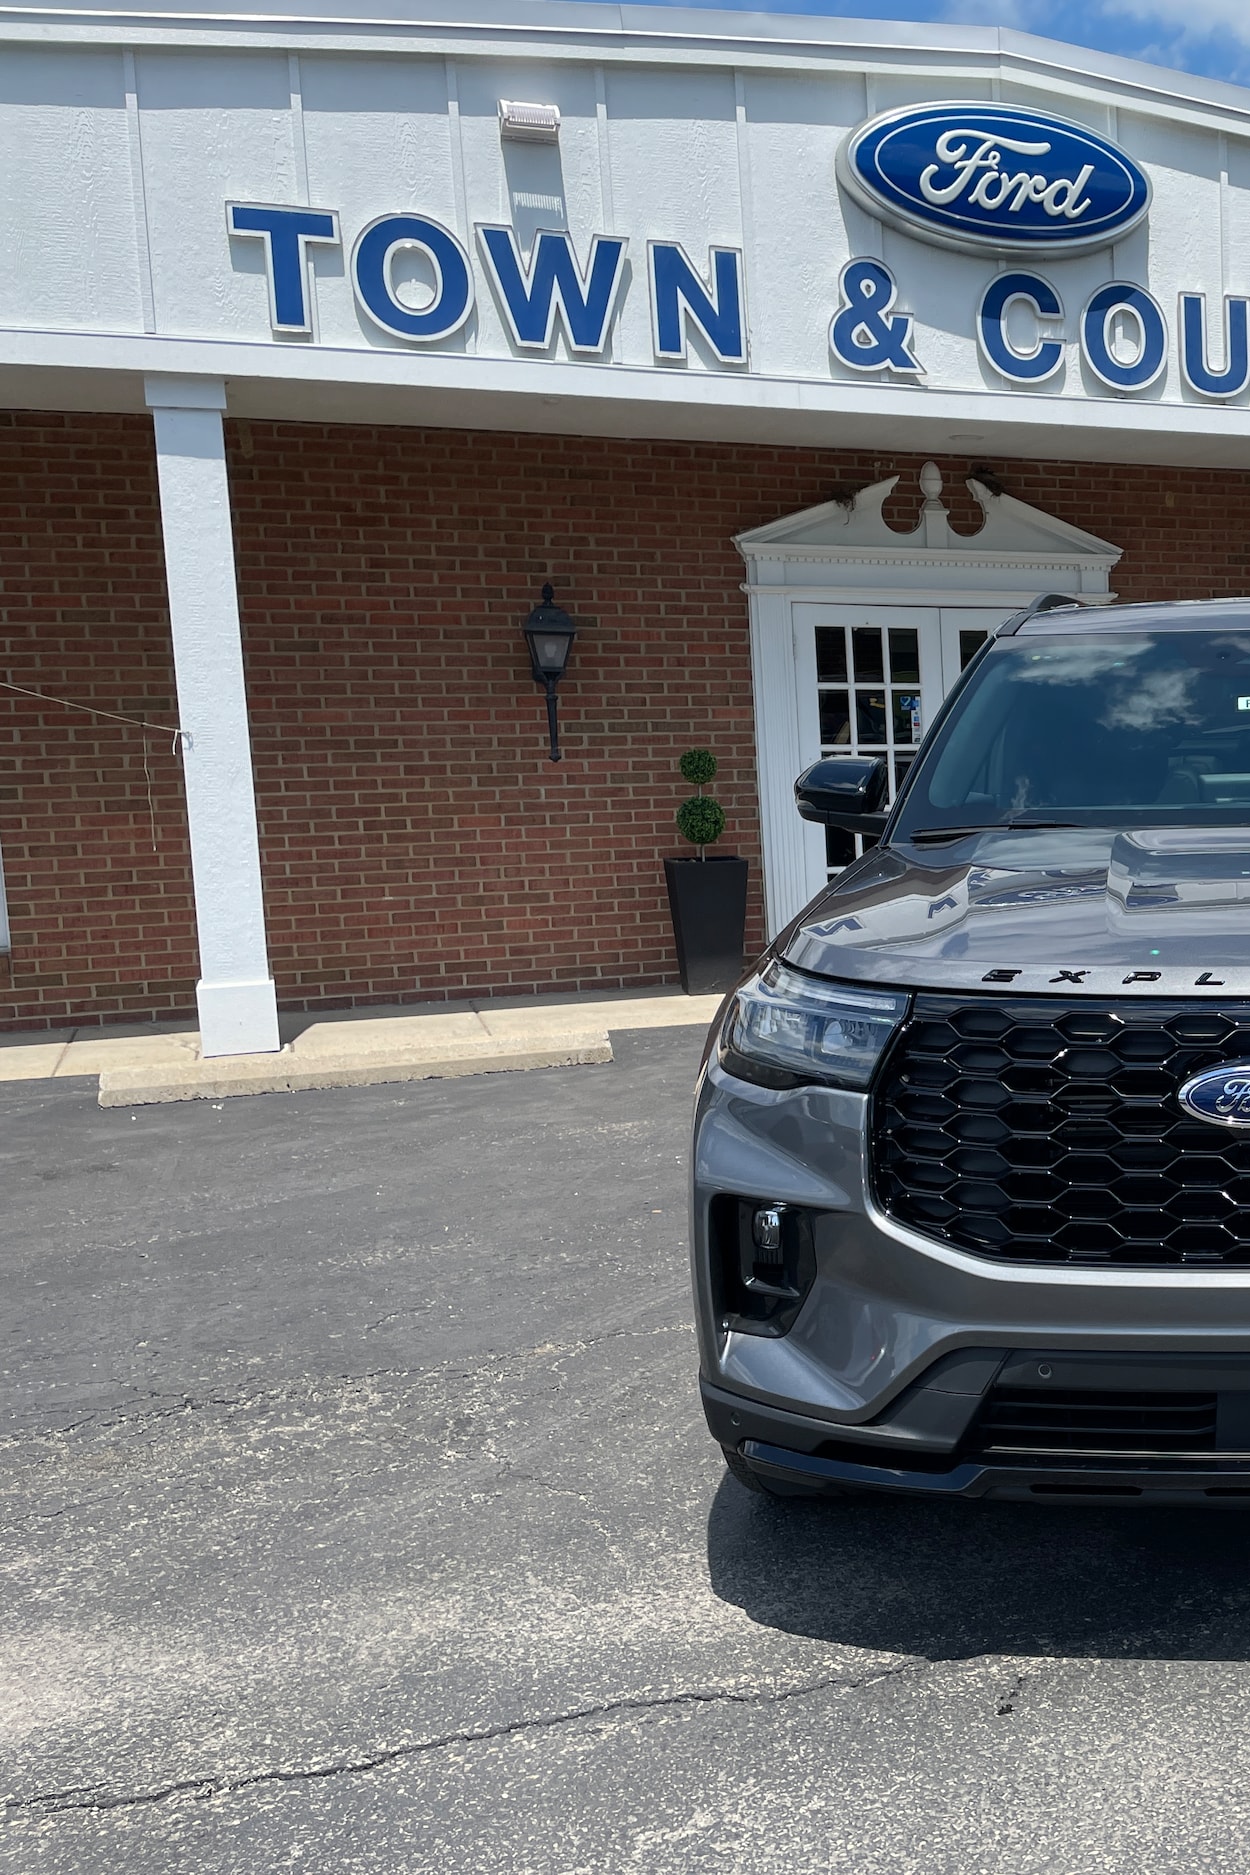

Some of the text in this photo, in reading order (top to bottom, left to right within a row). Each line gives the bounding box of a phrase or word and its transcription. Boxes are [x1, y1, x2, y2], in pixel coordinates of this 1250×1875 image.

[919, 129, 1095, 219] Ford
[226, 201, 748, 364] TOWN
[829, 256, 927, 375] &
